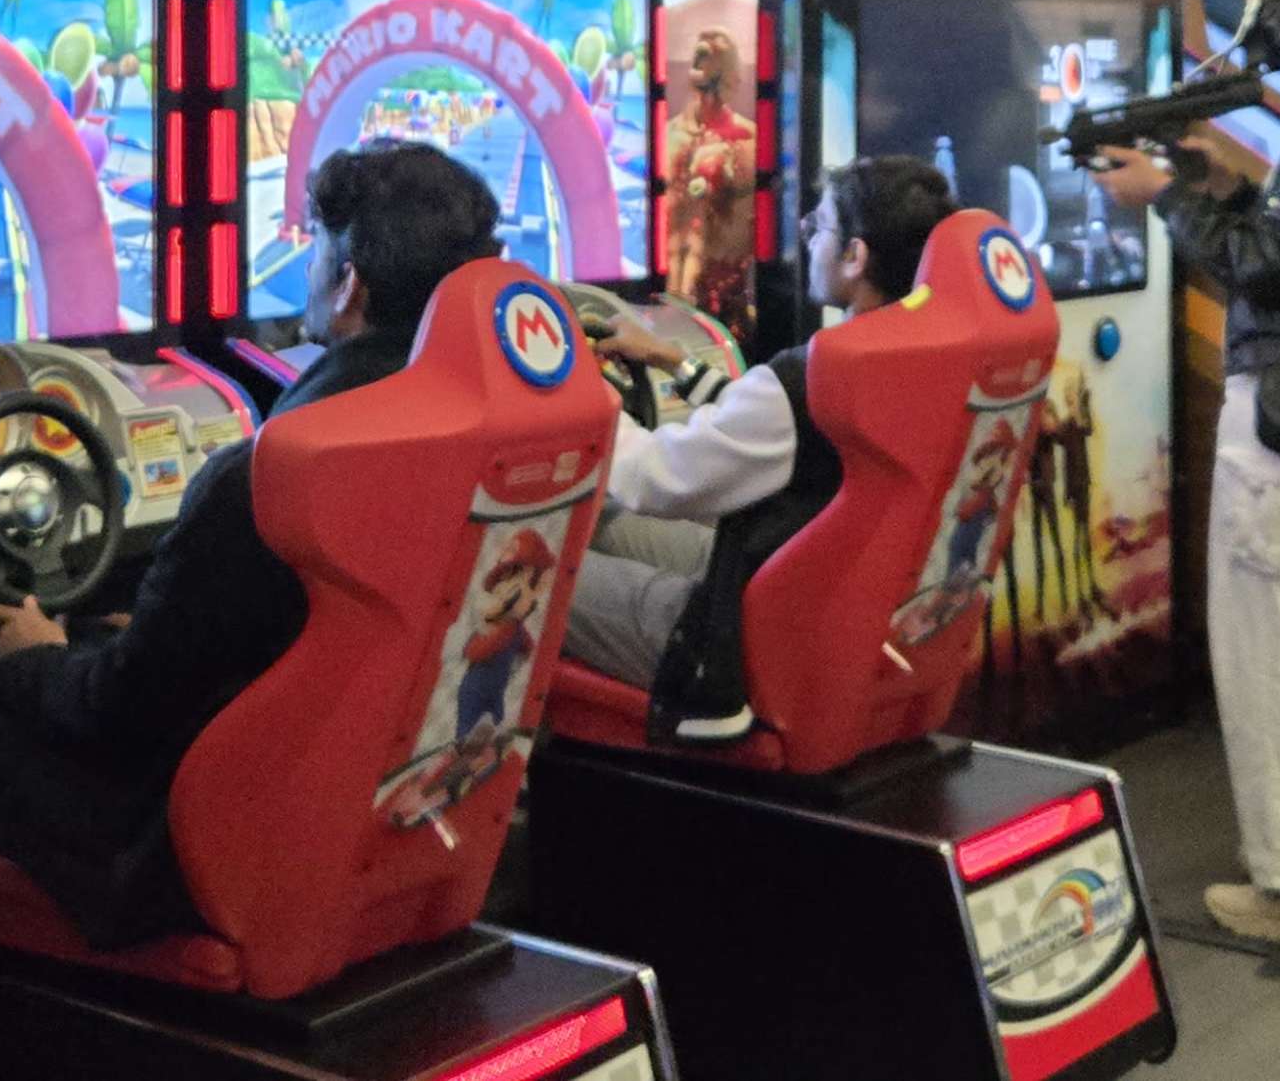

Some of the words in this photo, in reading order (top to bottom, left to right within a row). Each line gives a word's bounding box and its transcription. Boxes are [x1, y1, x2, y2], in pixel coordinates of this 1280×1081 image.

[307, 11, 417, 118] MARIO
[431, 7, 564, 118] KART
[995, 248, 1025, 280] M
[516, 305, 561, 354] M
